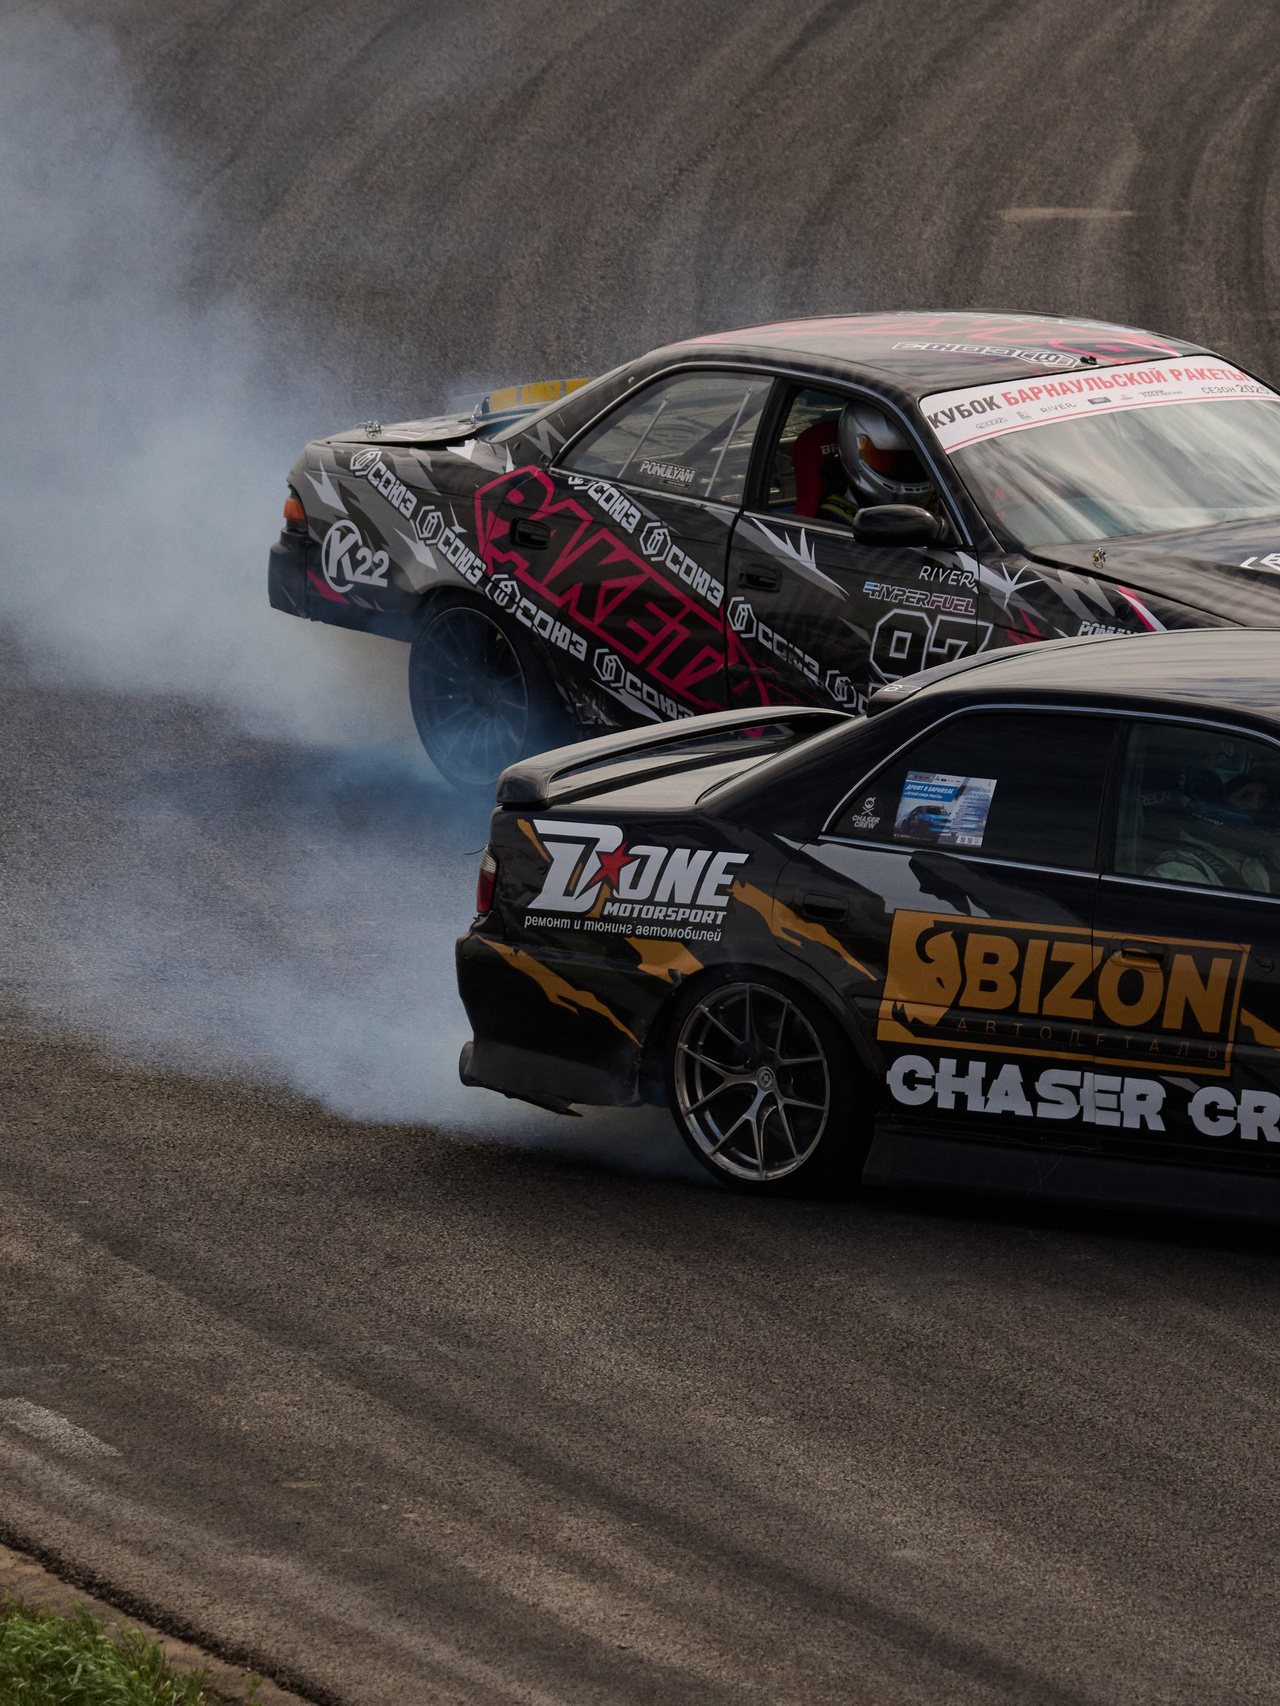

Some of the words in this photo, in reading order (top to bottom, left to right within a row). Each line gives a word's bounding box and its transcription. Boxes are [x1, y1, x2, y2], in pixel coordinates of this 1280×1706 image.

[927, 395, 1002, 429] КУБОК
[1001, 368, 1168, 407] БАРНАУЛЬСКОЙ
[1169, 368, 1250, 385] РАКЕТЫ
[1201, 386, 1236, 395] СЕЗОН
[1236, 383, 1270, 395] 2025
[918, 566, 977, 588] RIVER
[852, 815, 881, 825] CHASER
[854, 821, 877, 829] CREW
[603, 902, 727, 925] MOTORSPORT
[524, 915, 571, 929] ремонт
[574, 920, 581, 930] и
[584, 920, 632, 934] тюнинг
[635, 923, 722, 942] автомобилей
[958, 931, 1234, 1034] BIZON
[886, 1054, 1167, 1132] CHASER
